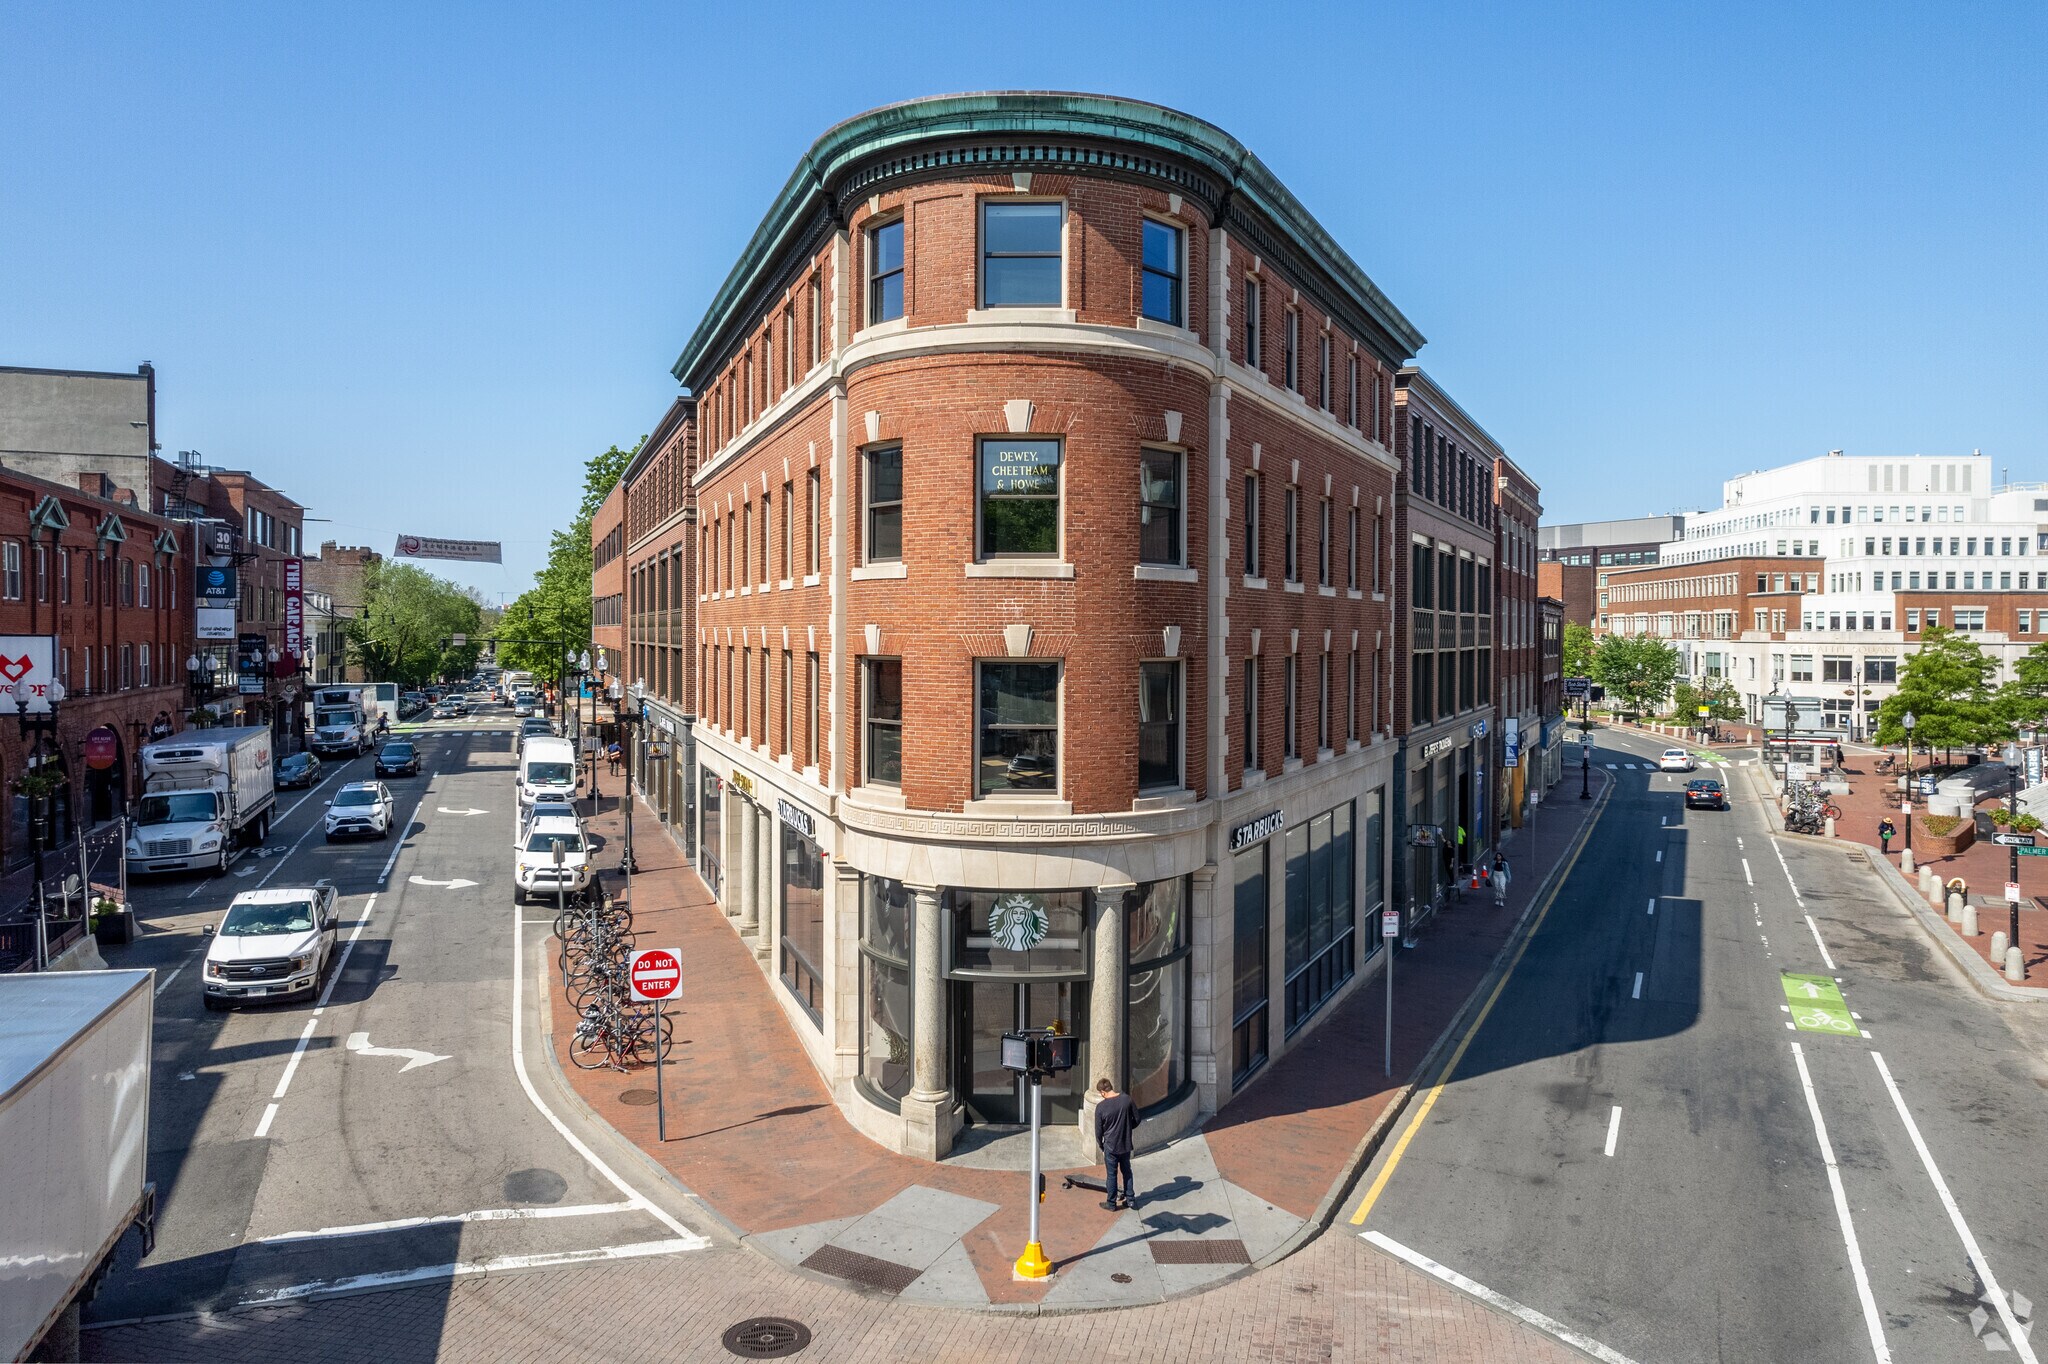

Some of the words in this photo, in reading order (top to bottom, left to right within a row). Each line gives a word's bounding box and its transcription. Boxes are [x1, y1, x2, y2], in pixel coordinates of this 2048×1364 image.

[1000, 451, 1039, 462] DEWEY,
[992, 465, 1048, 476] CHEETHAM
[997, 479, 1004, 489] &
[1011, 479, 1040, 489] HOWE
[216, 532, 230, 544] 30
[286, 561, 300, 591] THE
[205, 587, 227, 595] AT&T
[286, 597, 300, 652] GARAGE
[2028, 750, 2039, 777] BREW
[1236, 810, 1284, 848] STARBUCKS
[2020, 847, 2047, 855] PALMER
[638, 960, 650, 969] DO
[655, 959, 673, 968] NOT
[642, 981, 671, 990] ENTER
